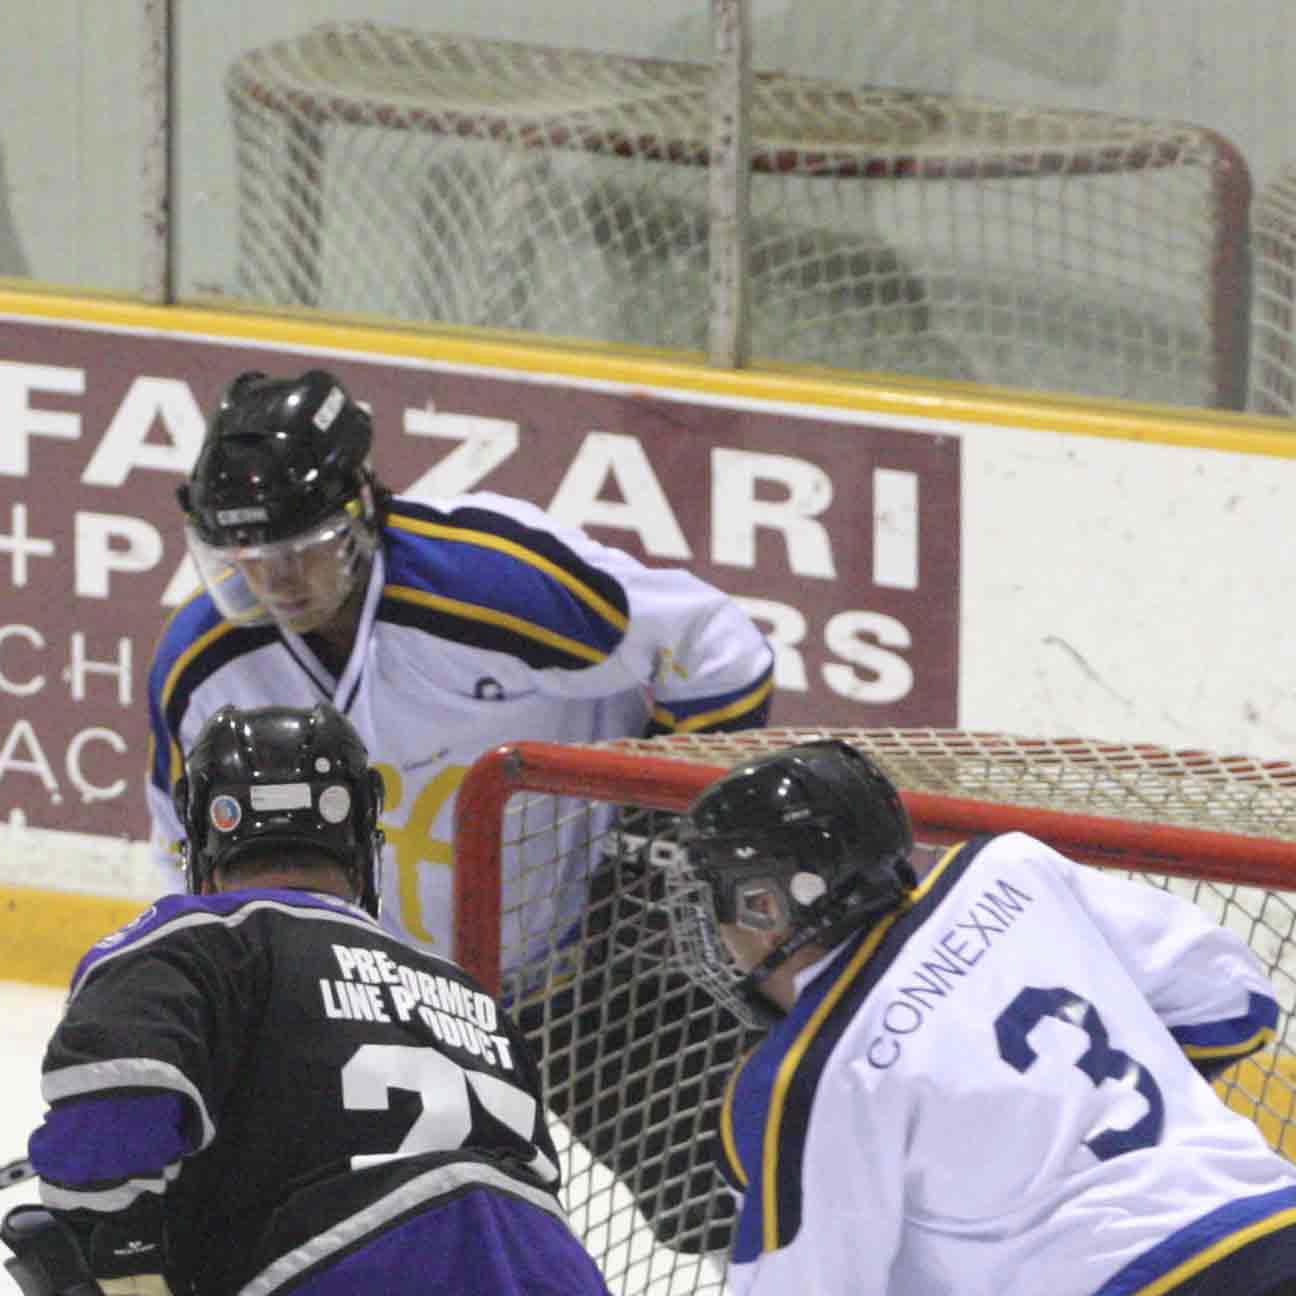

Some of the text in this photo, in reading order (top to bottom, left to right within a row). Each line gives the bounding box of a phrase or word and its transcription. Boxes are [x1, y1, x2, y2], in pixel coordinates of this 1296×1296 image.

[319, 979, 514, 1070] LINE PODUCT
[331, 944, 498, 1033] PREORMED
[867, 879, 1034, 1070] CONNEXIM
[993, 985, 1165, 1163] 3
